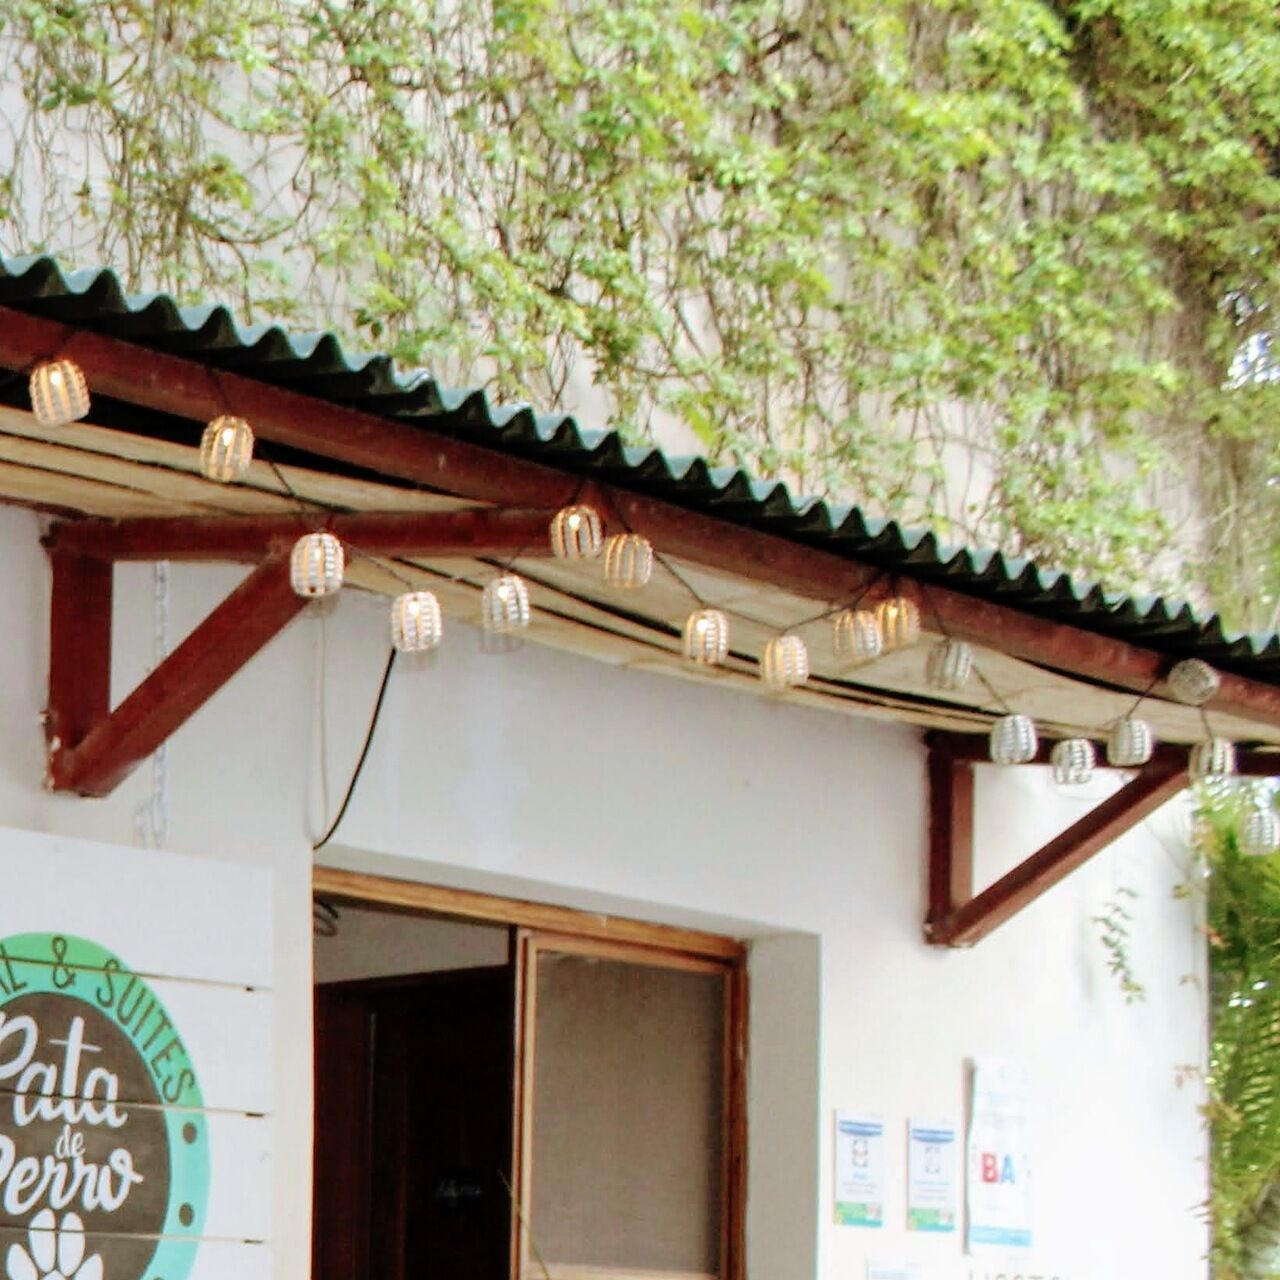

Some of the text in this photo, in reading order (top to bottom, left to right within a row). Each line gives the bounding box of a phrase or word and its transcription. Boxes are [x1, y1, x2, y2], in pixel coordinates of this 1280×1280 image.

[52, 936, 75, 989] &
[96, 959, 195, 1103] SUITES
[55, 1124, 86, 1158] de
